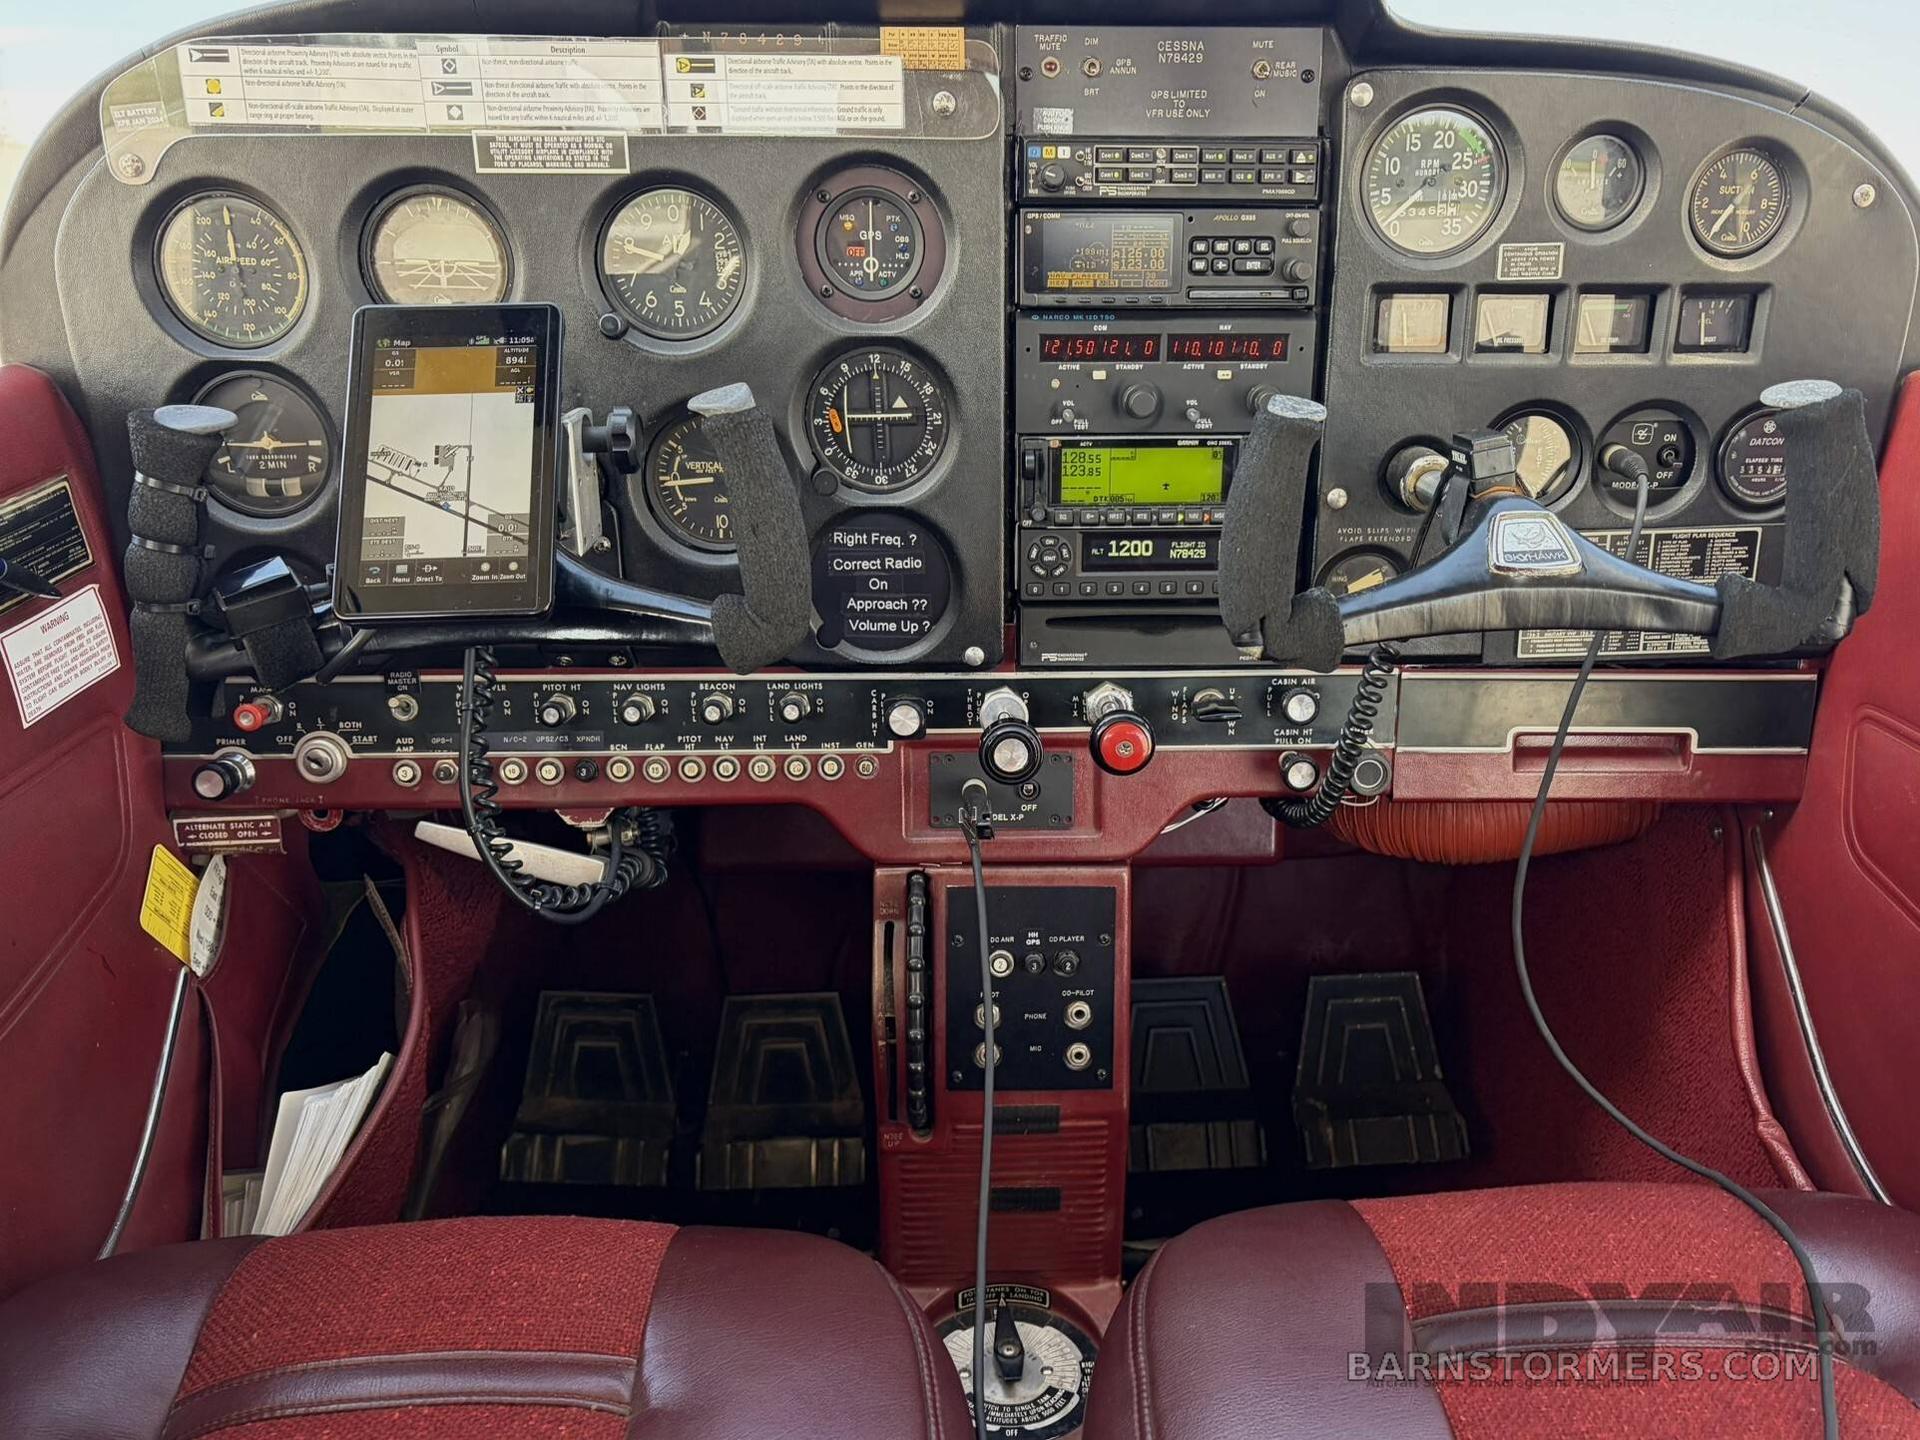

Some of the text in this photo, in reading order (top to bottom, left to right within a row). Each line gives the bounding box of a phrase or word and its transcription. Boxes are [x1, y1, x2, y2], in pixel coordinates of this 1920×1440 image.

[1034, 34, 1068, 43] TRAFFIC
[436, 45, 459, 53] Symbol
[1158, 41, 1204, 51] CESSNA
[1252, 40, 1274, 48] MUTE
[550, 46, 586, 54] Description
[1158, 53, 1204, 63] N78429
[1110, 66, 1137, 74] ANNUN
[1274, 70, 1297, 78] MUSIC
[1084, 88, 1099, 96] BRT
[1151, 90, 1207, 100] GPS LIMITED
[1254, 90, 1266, 98] ON
[1174, 100, 1186, 108] TO
[1146, 109, 1211, 118] VFR USE ONLY
[1406, 133, 1421, 152] 15
[1433, 131, 1455, 149] 20
[1421, 159, 1440, 168] RPM
[1452, 152, 1473, 170] 25
[1385, 157, 1400, 176] 10
[1459, 180, 1478, 198] 30
[667, 205, 679, 221] 0
[1441, 219, 1462, 235] 35
[1740, 221, 1750, 232] 10
[859, 231, 882, 240] GPS
[394, 340, 411, 348] Map
[1044, 340, 1096, 356] 121.50
[1172, 340, 1224, 356] 110.10
[506, 356, 523, 365] 894
[869, 354, 880, 363] 12
[900, 360, 912, 372] 15
[923, 382, 934, 395] 18
[933, 413, 942, 425] 21
[1664, 434, 1676, 442] ON
[1750, 438, 1785, 446] DATCON
[925, 442, 937, 456] 24
[1062, 452, 1102, 464] 128.55
[259, 461, 287, 469] 2 MIN
[685, 461, 723, 470] VERTICAL
[845, 467, 859, 479] 33
[905, 465, 918, 478] 27
[1062, 465, 1102, 477] 123.85
[875, 476, 888, 484] 30
[716, 514, 728, 528] 10
[834, 532, 917, 547] Right Freq. ?
[1108, 540, 1153, 558] 1200
[1169, 549, 1206, 559] N78429
[1504, 551, 1567, 563] SKYHAWK
[833, 557, 922, 570] Correct Radio
[869, 578, 888, 590] On
[847, 598, 928, 611] Approach ??
[40, 611, 70, 634] WARNING
[849, 620, 930, 634] Volume Up ?
[184, 823, 225, 831] ALTERNATE
[237, 830, 258, 838] OPEN
[1010, 1292, 1043, 1302] LANDING
[1015, 1403, 1035, 1412] SINGLE
[1005, 1429, 1018, 1437] OFF
